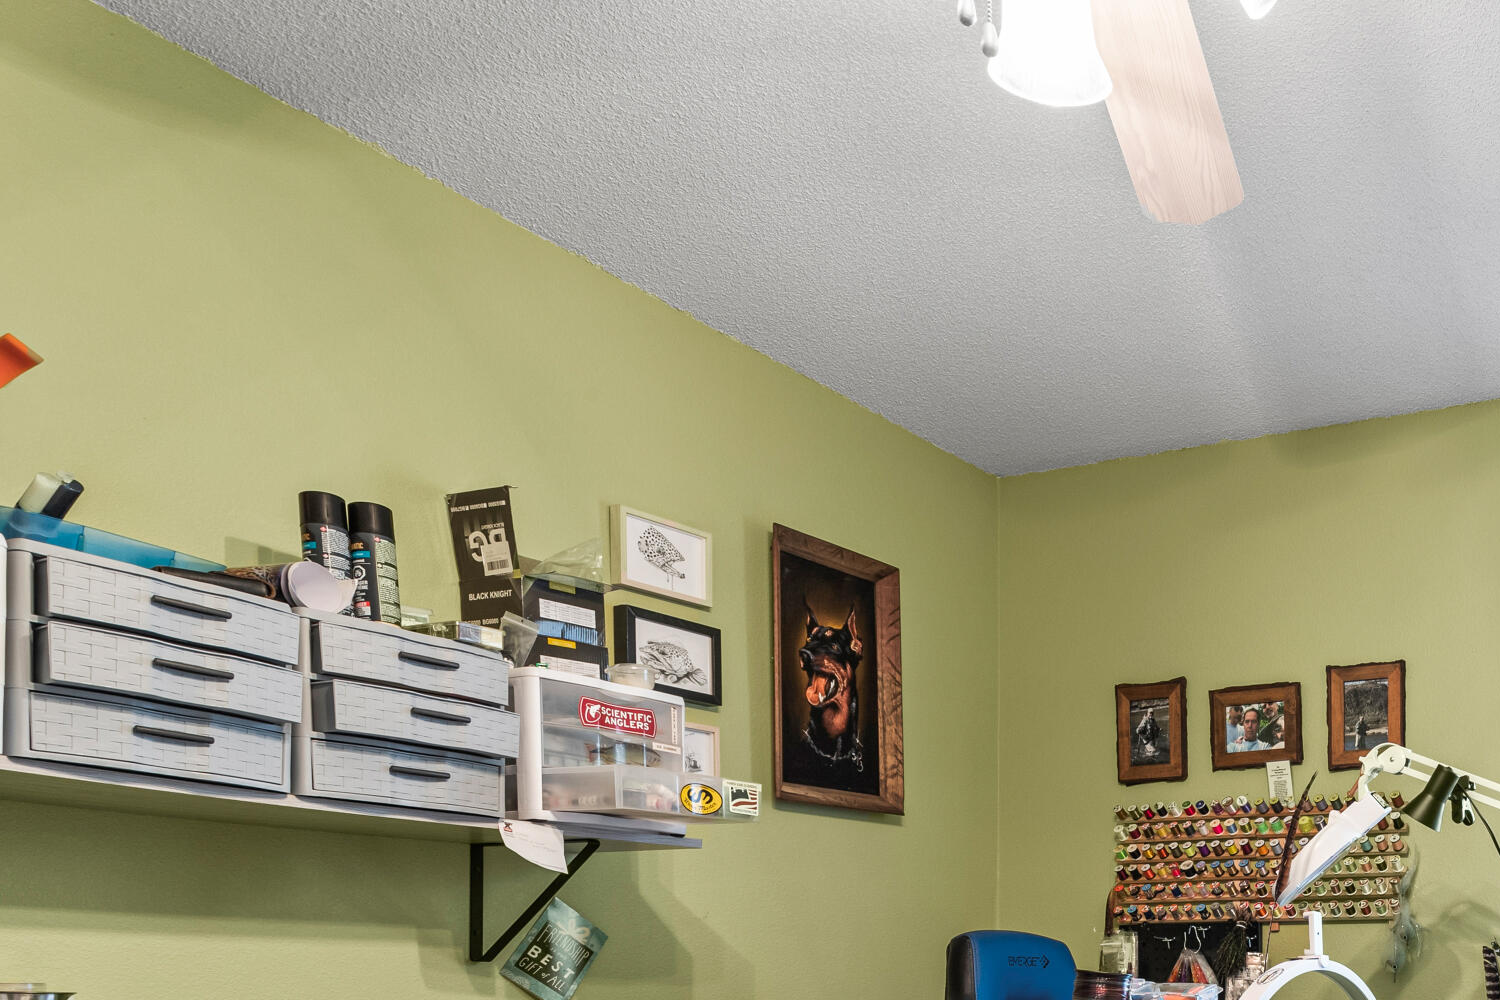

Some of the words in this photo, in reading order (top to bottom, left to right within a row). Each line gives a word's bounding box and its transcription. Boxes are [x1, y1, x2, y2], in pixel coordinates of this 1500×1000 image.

[469, 592, 489, 600] BLACK
[490, 590, 512, 599] KNIGHT
[601, 706, 652, 723] SCIENTIFIC
[604, 716, 649, 730] ANGLERS
[537, 924, 590, 967] FRIENDSHIP
[518, 957, 543, 974] GIFT
[547, 976, 566, 991] ALL
[527, 945, 574, 978] BEST
